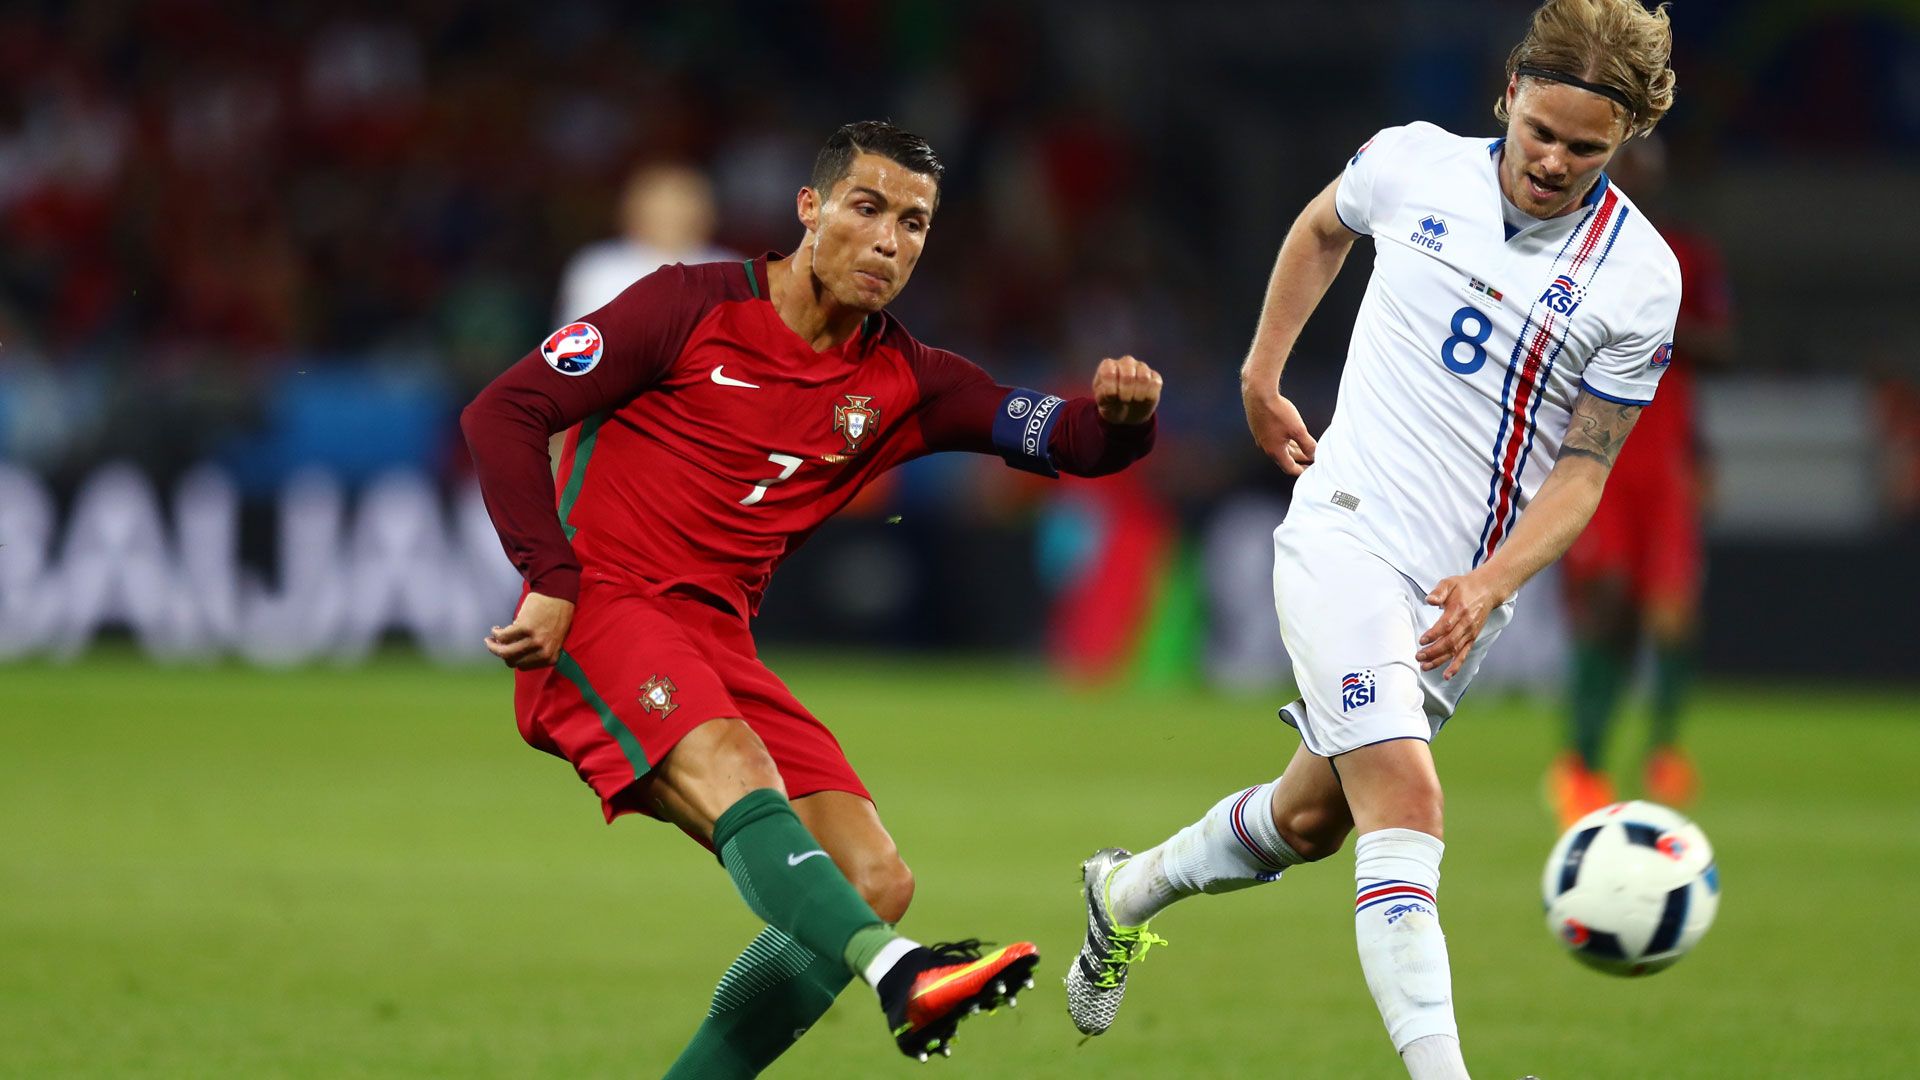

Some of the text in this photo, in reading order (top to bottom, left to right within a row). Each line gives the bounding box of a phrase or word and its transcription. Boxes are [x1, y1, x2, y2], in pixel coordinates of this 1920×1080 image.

[1441, 306, 1493, 375] 8
[1028, 419, 1041, 436] TO
[1026, 438, 1036, 456] NO
[739, 451, 804, 506] 7
